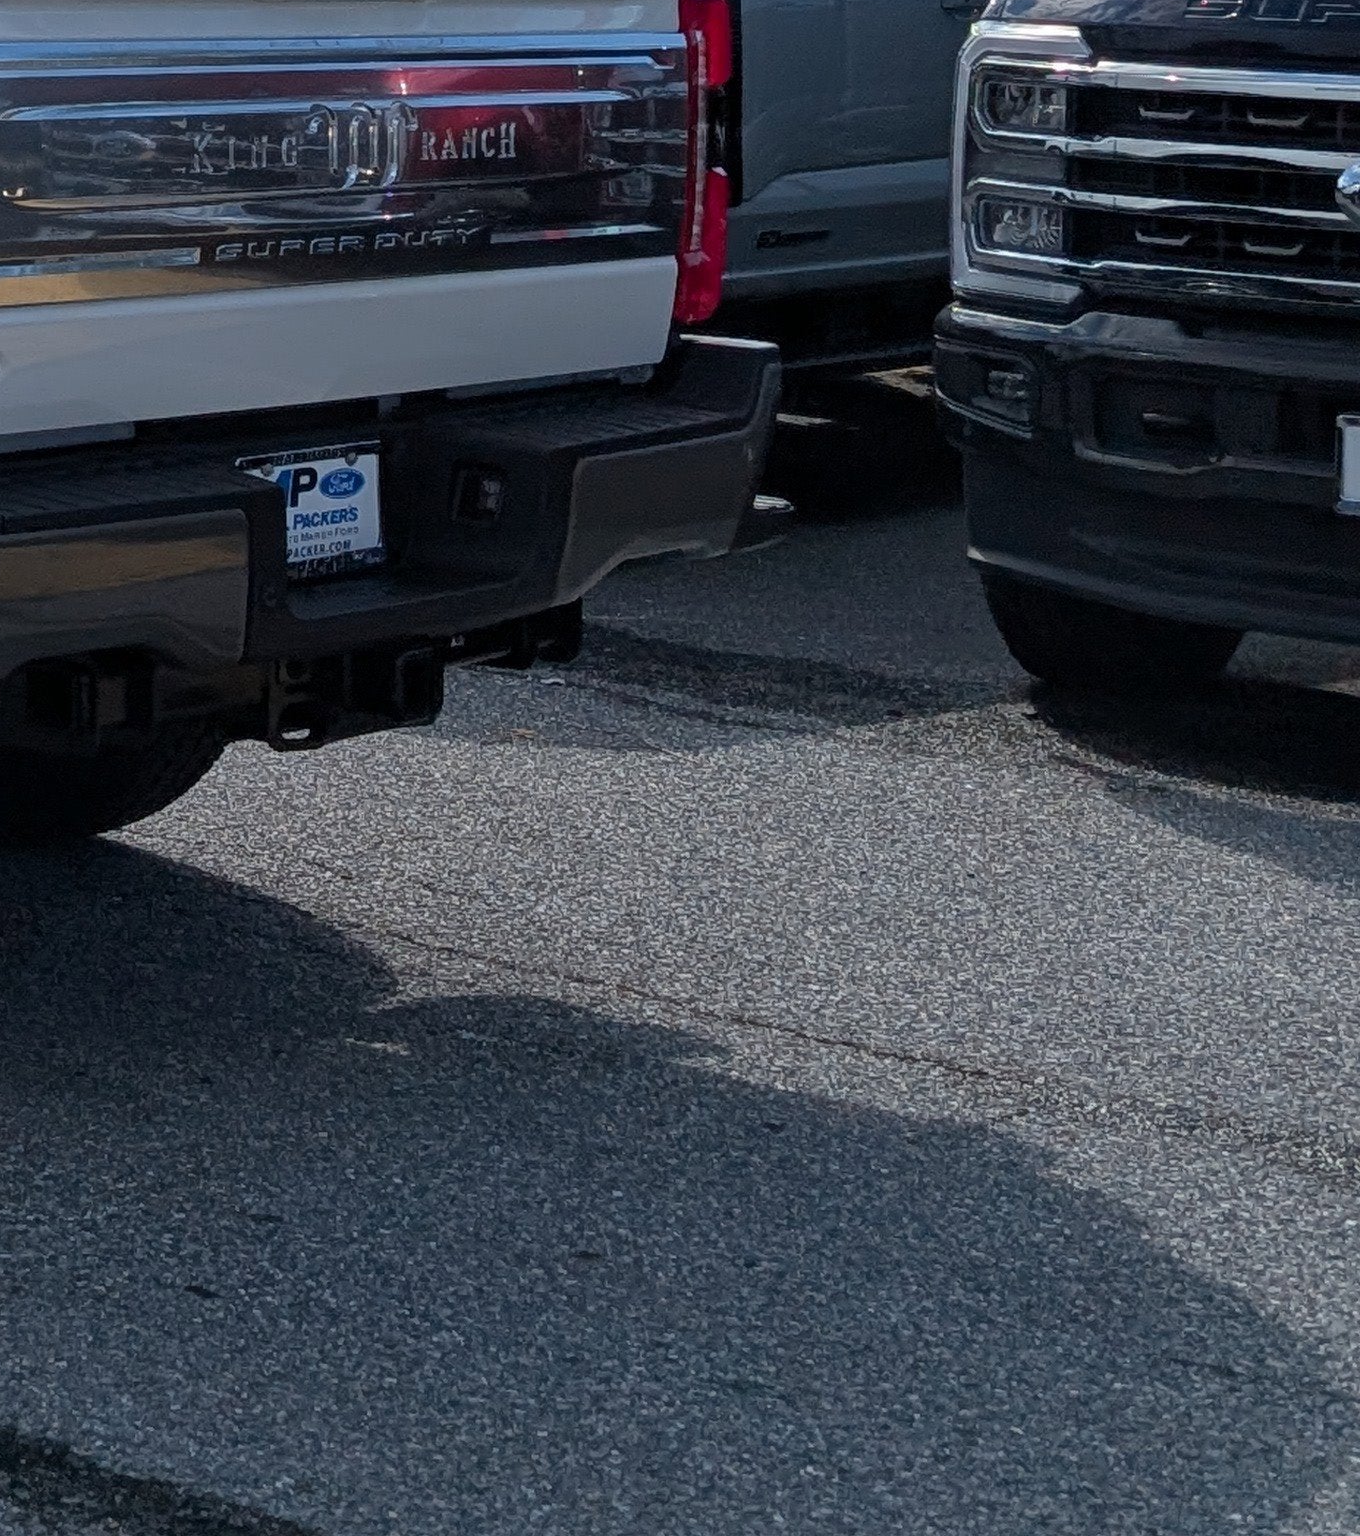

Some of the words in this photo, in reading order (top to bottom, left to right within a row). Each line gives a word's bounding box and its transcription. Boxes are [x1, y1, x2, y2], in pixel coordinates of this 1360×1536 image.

[191, 132, 299, 174] KING
[419, 122, 517, 162] RANCH
[215, 235, 366, 262] SUPER
[374, 227, 480, 250] DUTY
